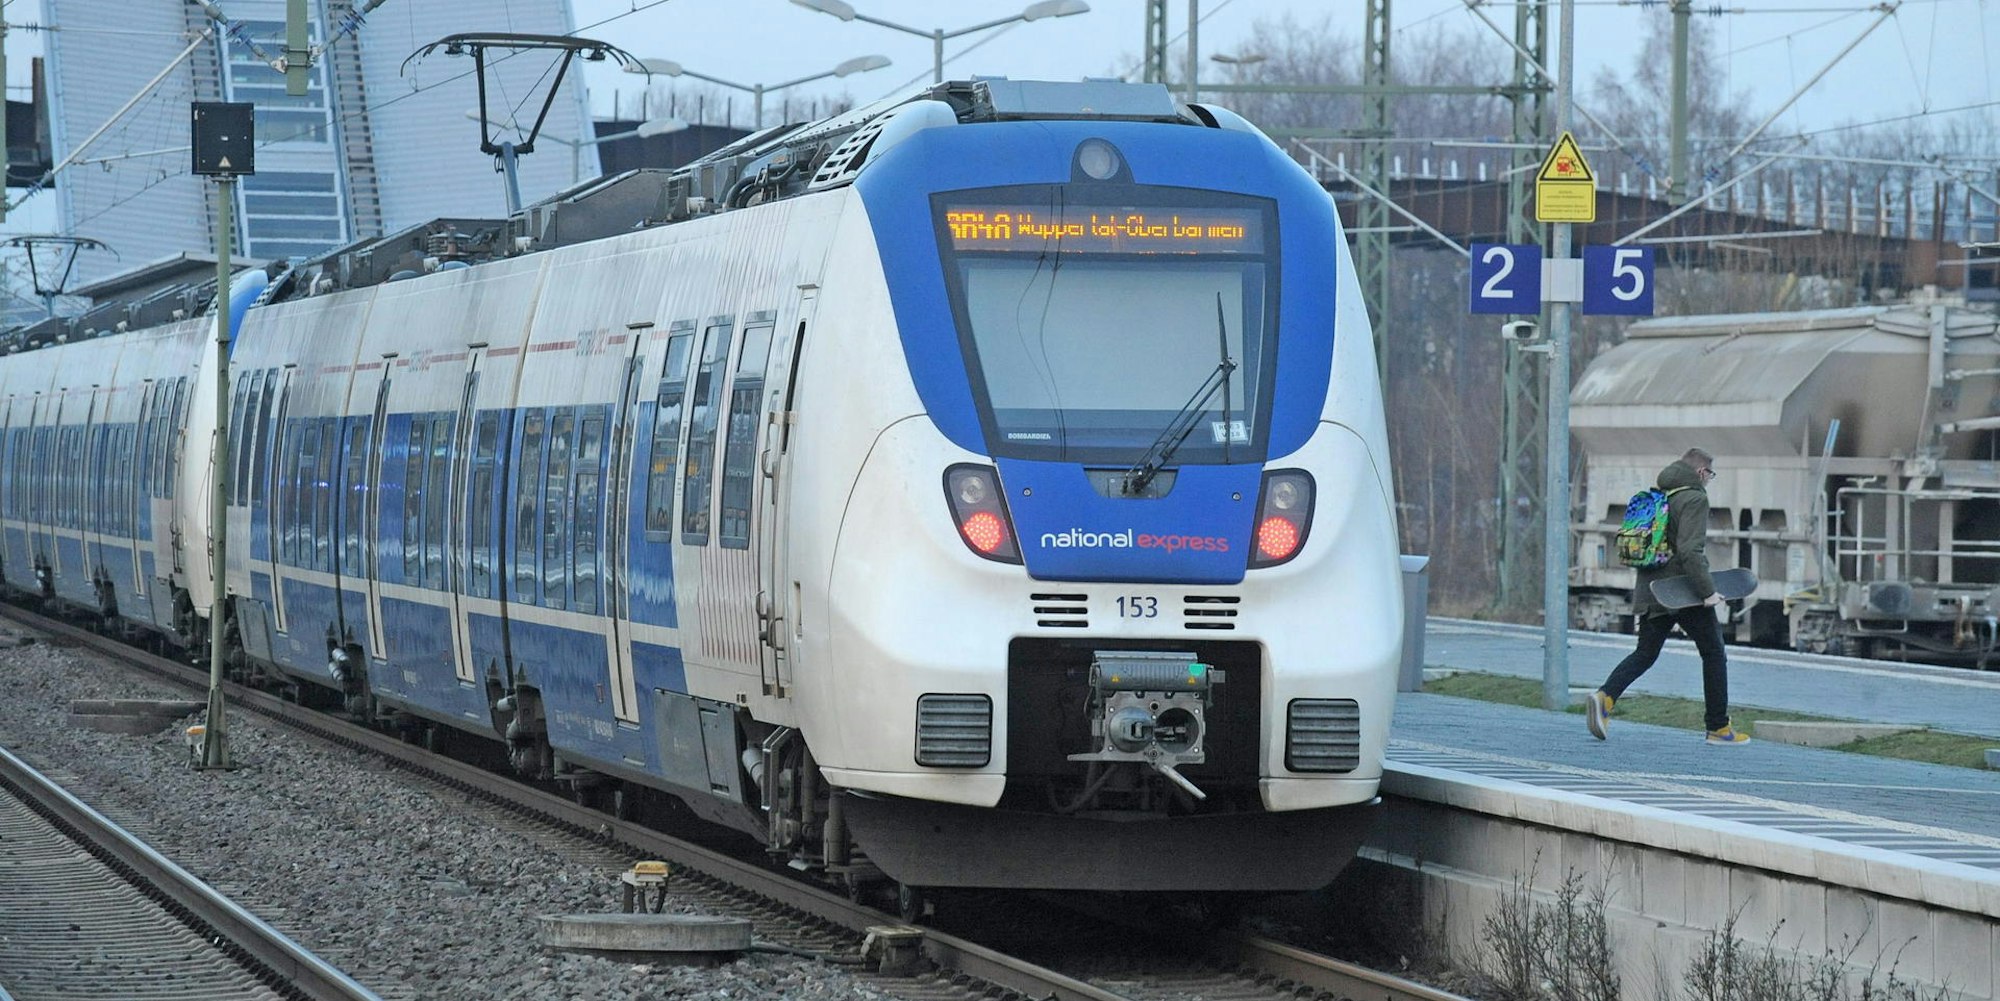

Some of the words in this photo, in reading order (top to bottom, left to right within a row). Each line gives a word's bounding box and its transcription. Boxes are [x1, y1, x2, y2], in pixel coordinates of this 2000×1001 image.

[1481, 246, 1514, 299] 2
[1611, 249, 1645, 301] 5
[1041, 528, 1133, 549] national
[1137, 533, 1229, 553] express
[1116, 596, 1158, 619] 153
